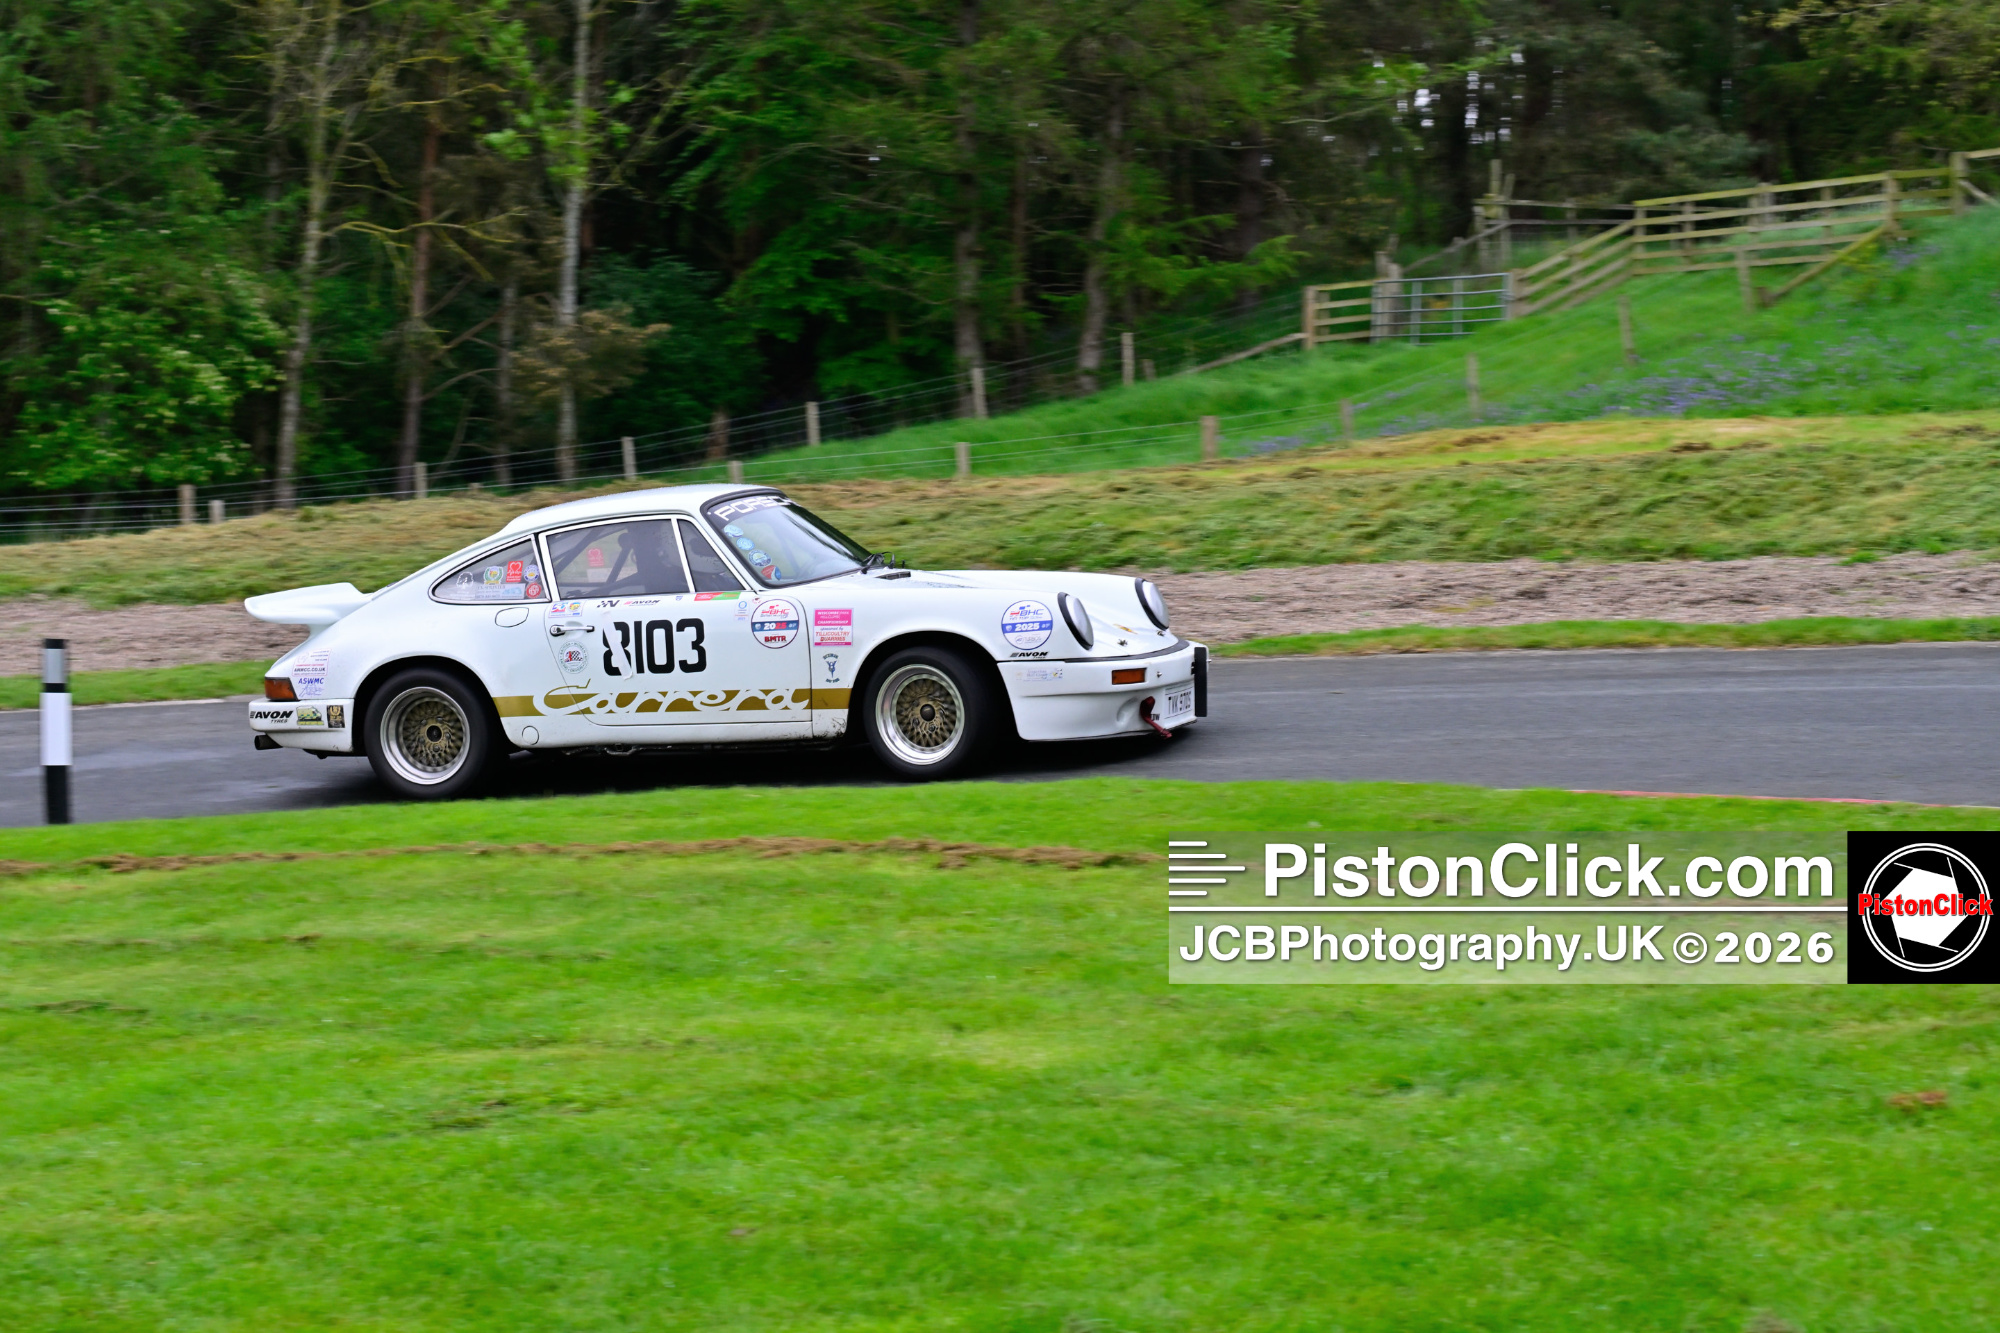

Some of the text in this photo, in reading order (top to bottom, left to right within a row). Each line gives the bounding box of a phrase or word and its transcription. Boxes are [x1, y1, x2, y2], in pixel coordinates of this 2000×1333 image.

[763, 622, 787, 630] 2025
[1014, 622, 1040, 632] 2025
[764, 635, 787, 643] BMTR
[298, 677, 325, 685] ASWMC
[533, 678, 810, 716] Carrera
[254, 710, 294, 719] AVON
